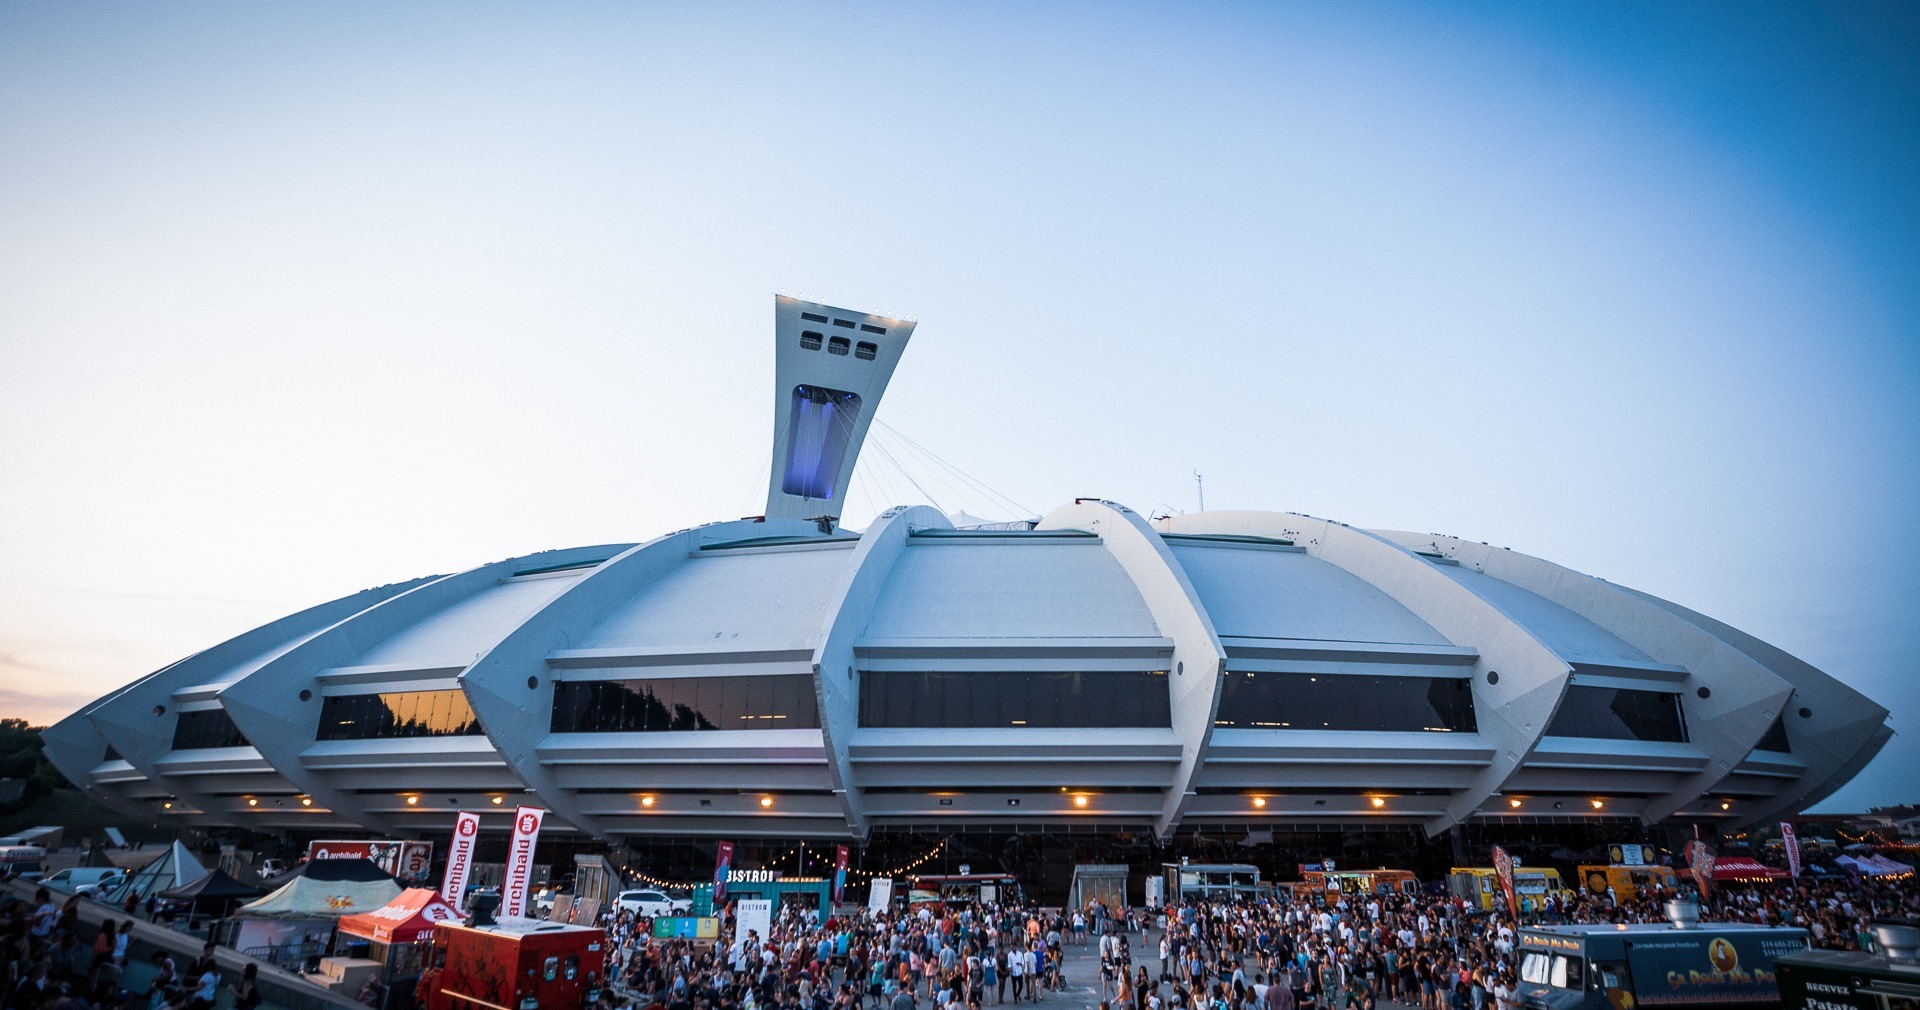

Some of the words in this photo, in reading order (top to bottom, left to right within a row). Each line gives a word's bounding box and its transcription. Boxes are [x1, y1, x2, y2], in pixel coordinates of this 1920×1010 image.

[448, 840, 470, 908] archibald
[509, 839, 531, 917] archibald
[1805, 982, 1850, 995] RECEVEZ
